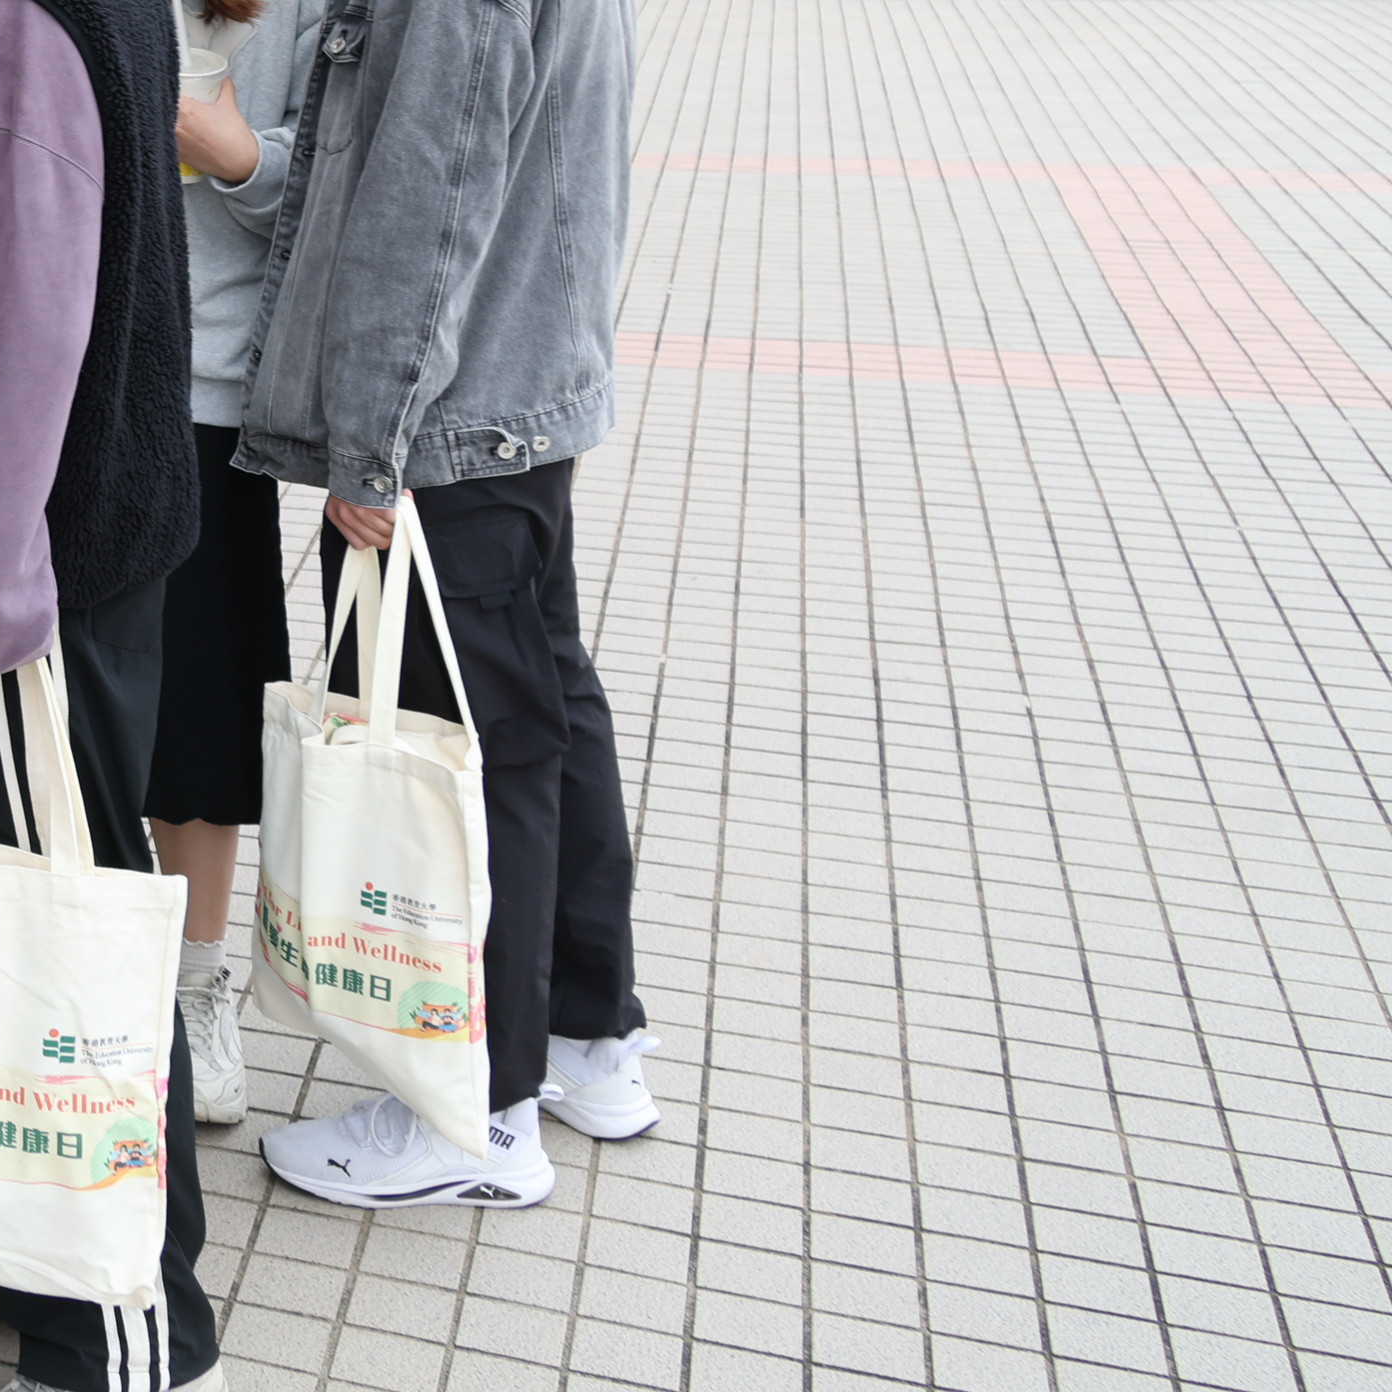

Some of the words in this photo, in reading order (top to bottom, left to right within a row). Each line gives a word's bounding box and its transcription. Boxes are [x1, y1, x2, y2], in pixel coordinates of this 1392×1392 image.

[286, 910, 301, 931] Li
[307, 932, 347, 950] and
[352, 936, 443, 973] Wellness
[32, 1090, 136, 1115] Wellness
[489, 1125, 516, 1150] MA
